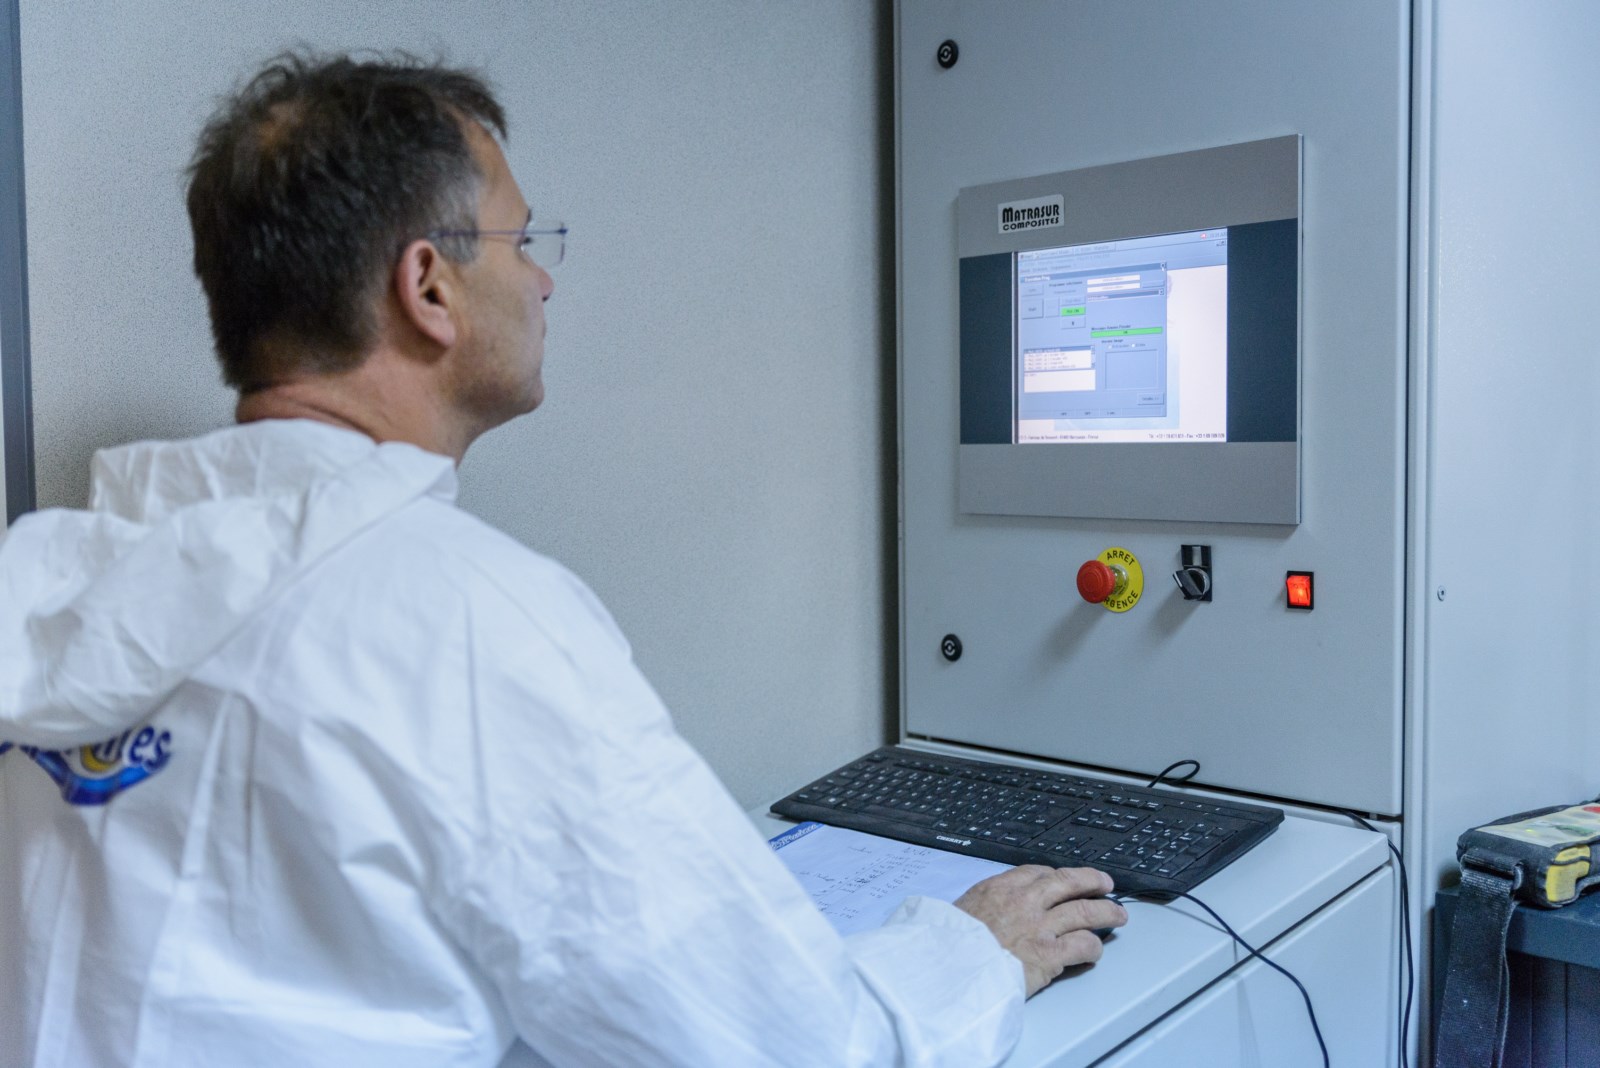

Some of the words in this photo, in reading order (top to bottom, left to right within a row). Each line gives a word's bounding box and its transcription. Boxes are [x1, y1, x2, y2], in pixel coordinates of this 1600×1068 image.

[1002, 204, 1060, 223] MATRASUR
[1002, 217, 1060, 231] COMPOSITES
[1106, 550, 1135, 566] ARRET
[1103, 590, 1139, 609] RGENCE
